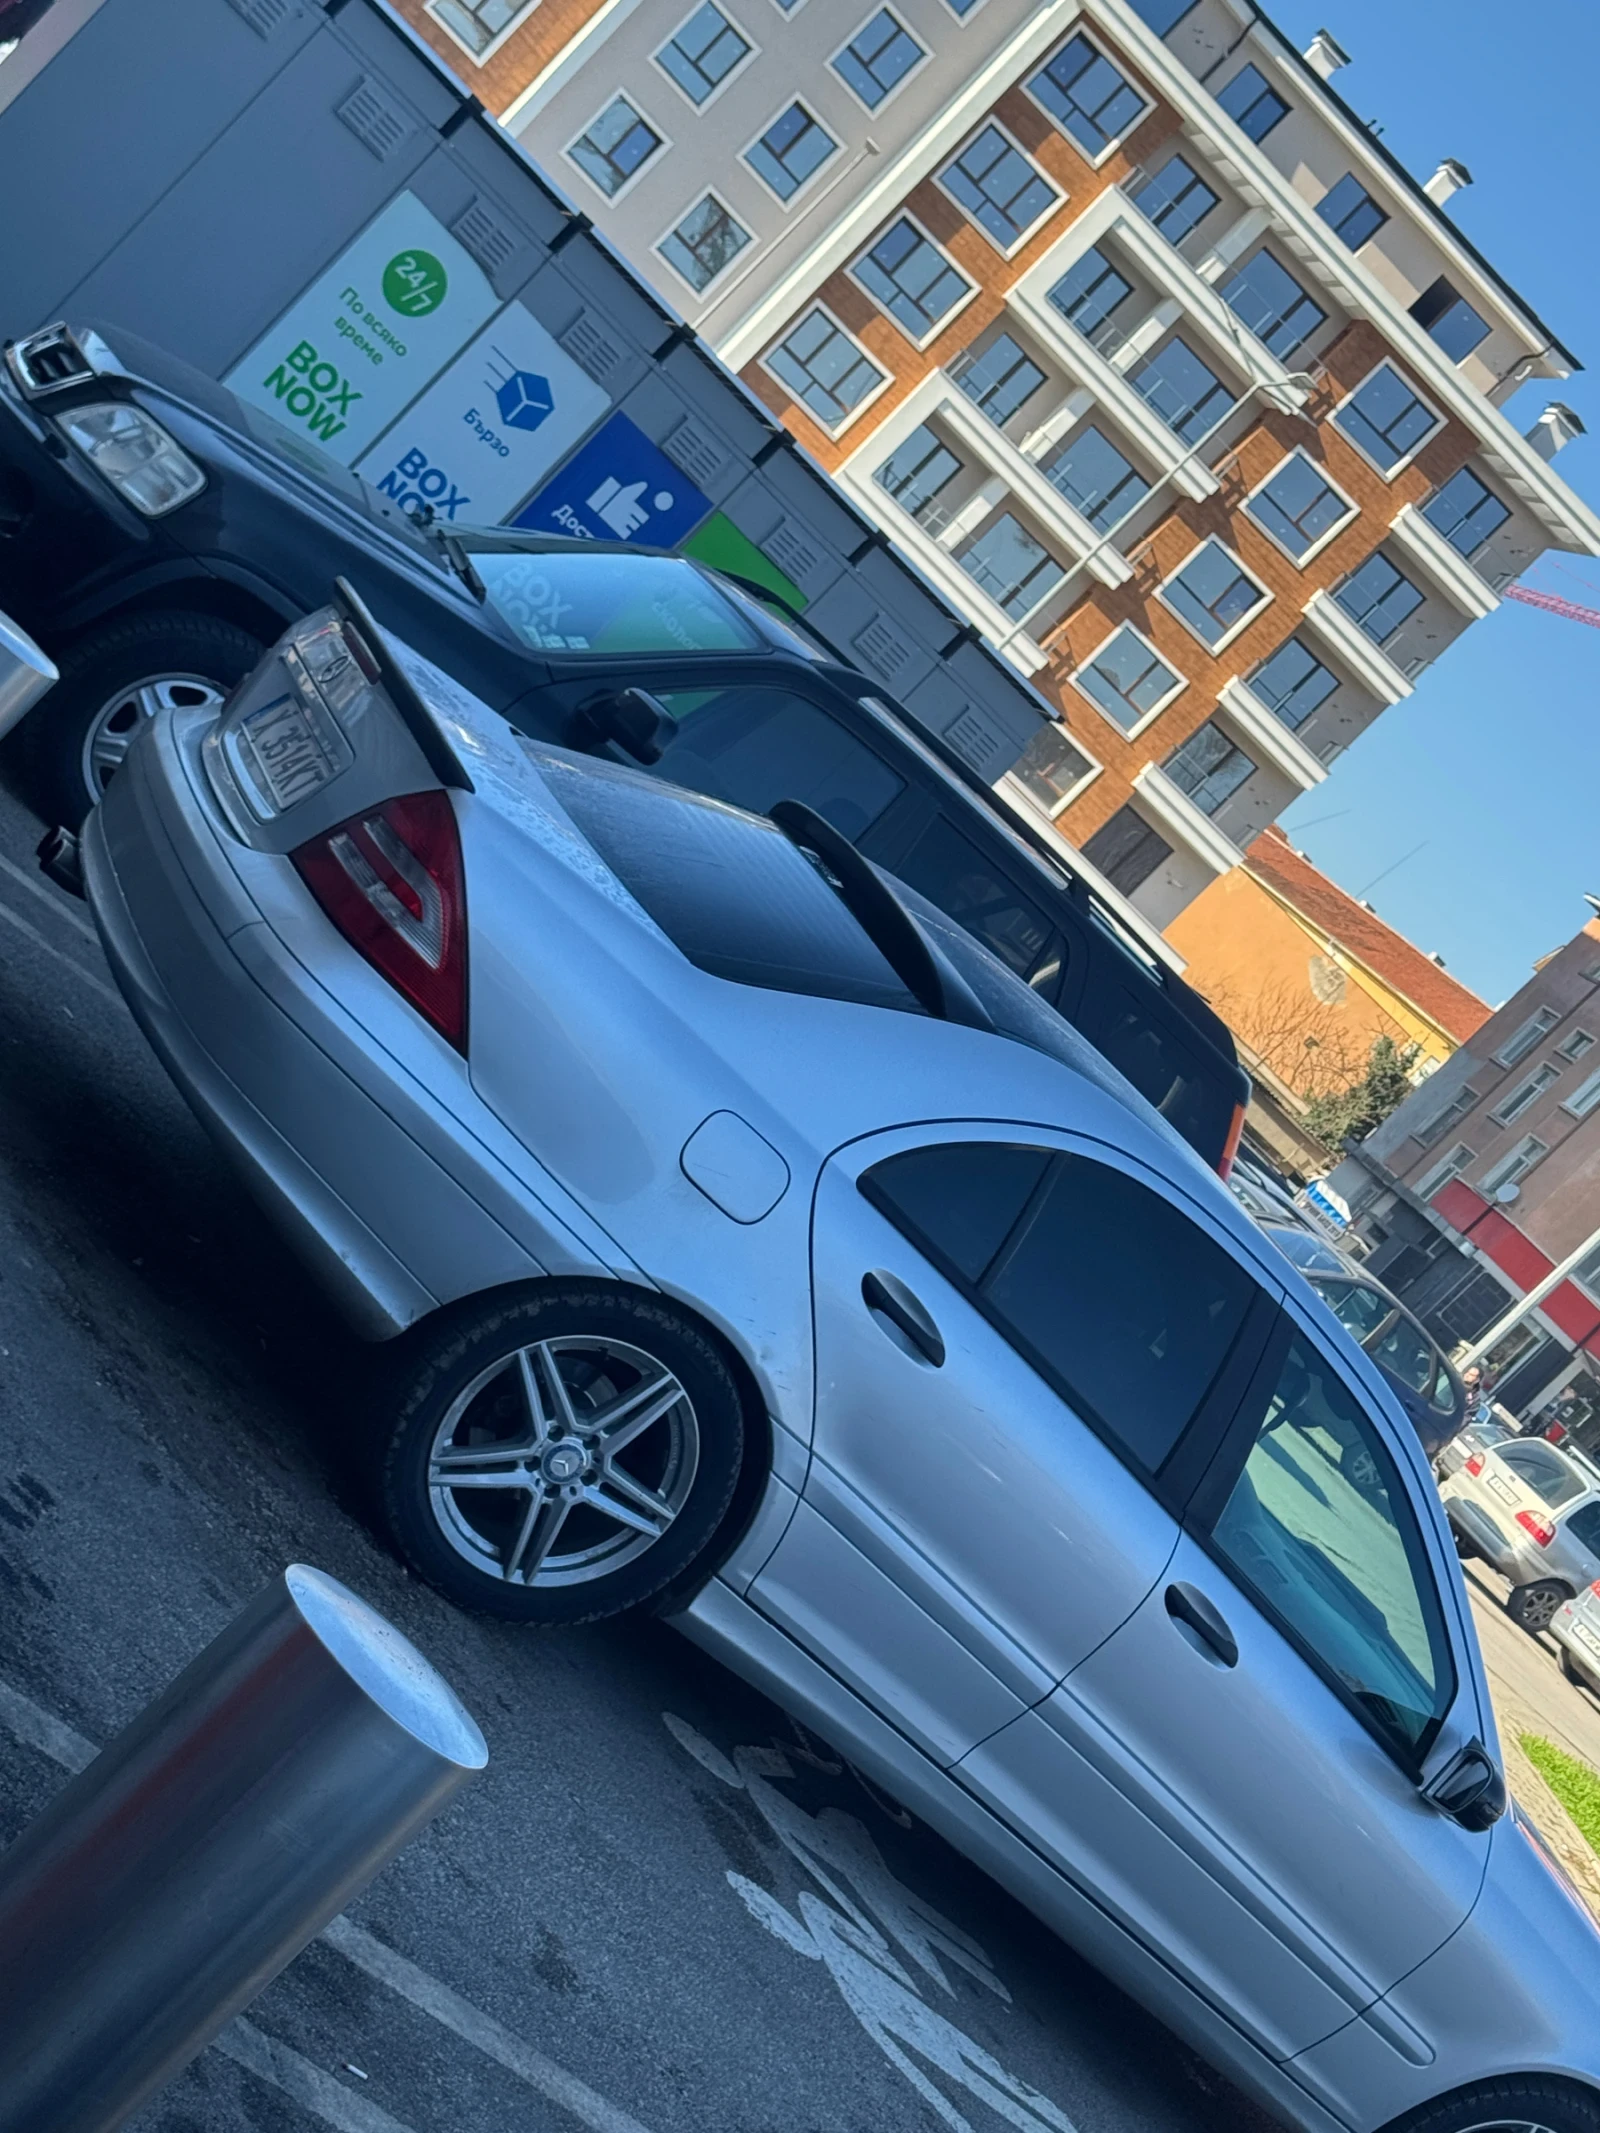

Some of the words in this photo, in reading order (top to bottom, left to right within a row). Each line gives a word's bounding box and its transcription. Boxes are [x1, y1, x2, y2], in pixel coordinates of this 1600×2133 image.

[395, 257, 438, 311] 24/7
[334, 316, 384, 365] време
[339, 287, 364, 315] По
[362, 312, 408, 357] всяко
[263, 364, 347, 442] NOW
[285, 340, 363, 416] BOX
[463, 408, 510, 458] Бързо
[376, 470, 427, 514] NO
[396, 447, 471, 521] BOX
